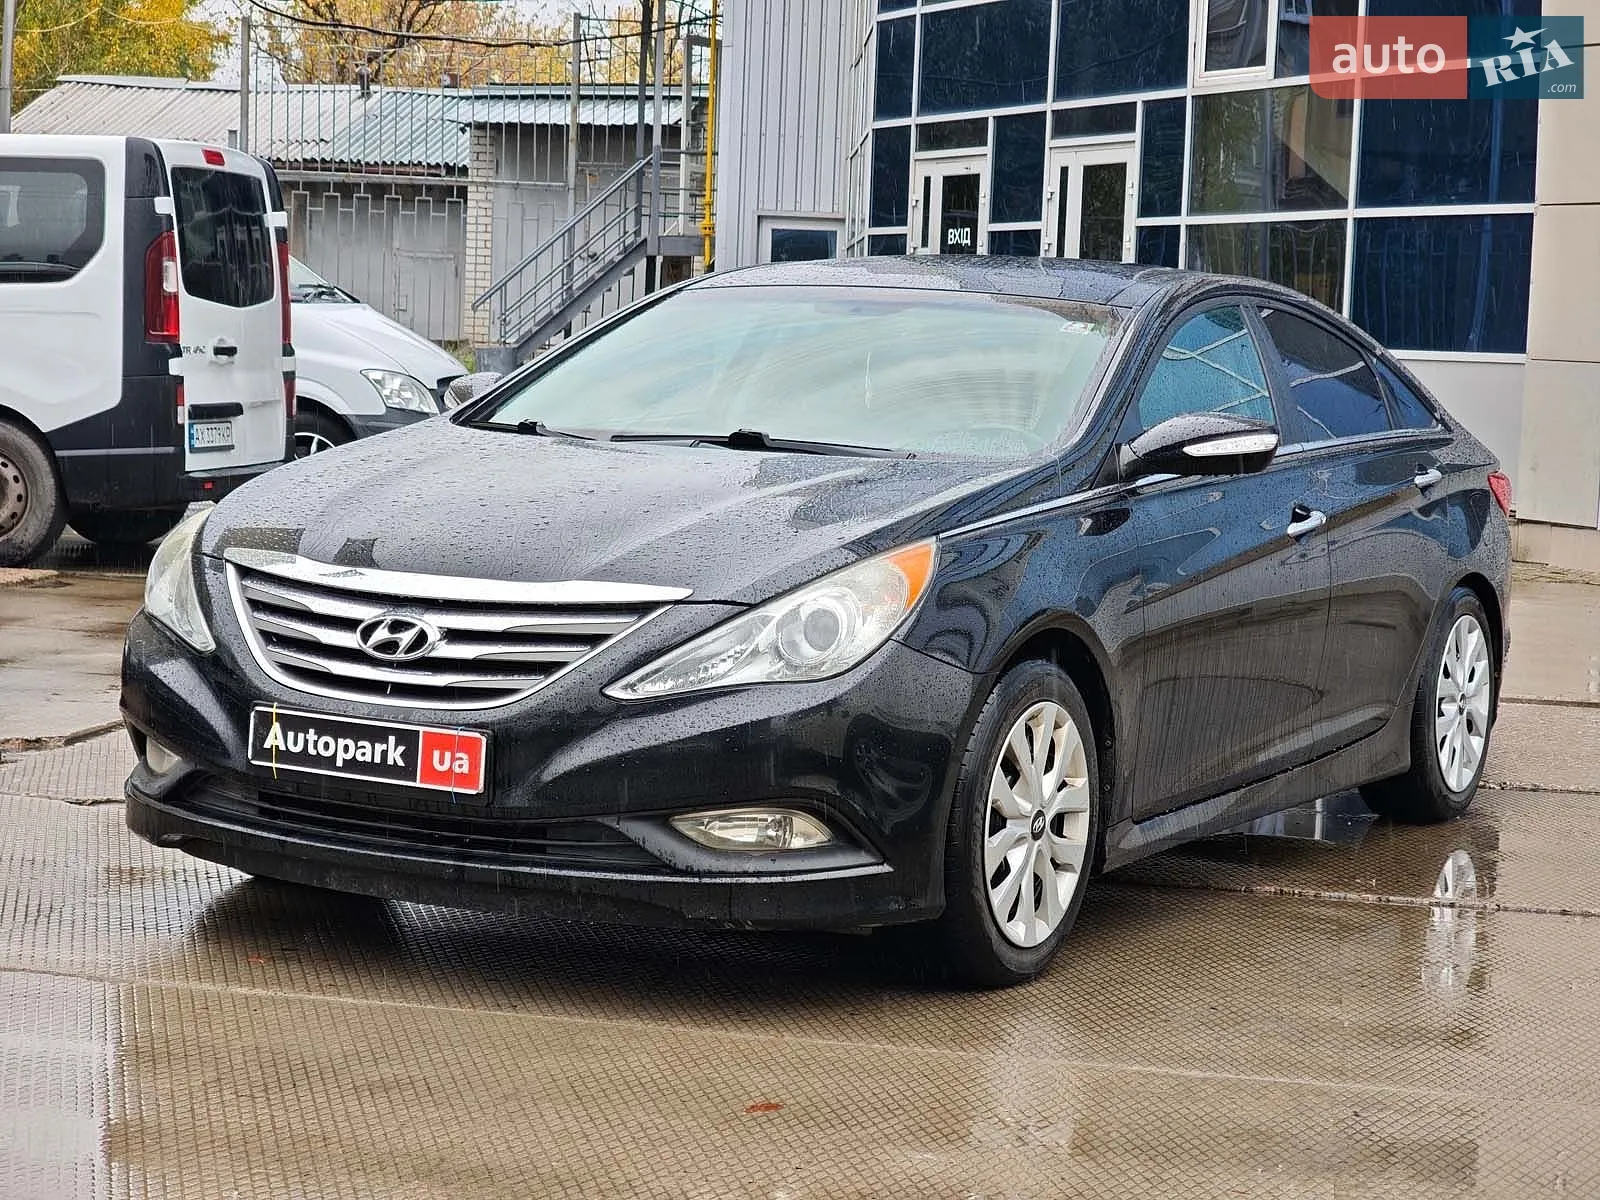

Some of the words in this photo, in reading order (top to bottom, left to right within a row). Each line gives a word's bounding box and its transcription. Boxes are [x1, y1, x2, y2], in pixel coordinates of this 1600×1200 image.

[948, 227, 971, 247] ВХІД
[263, 721, 406, 767] Autopark
[432, 749, 470, 775] ua
